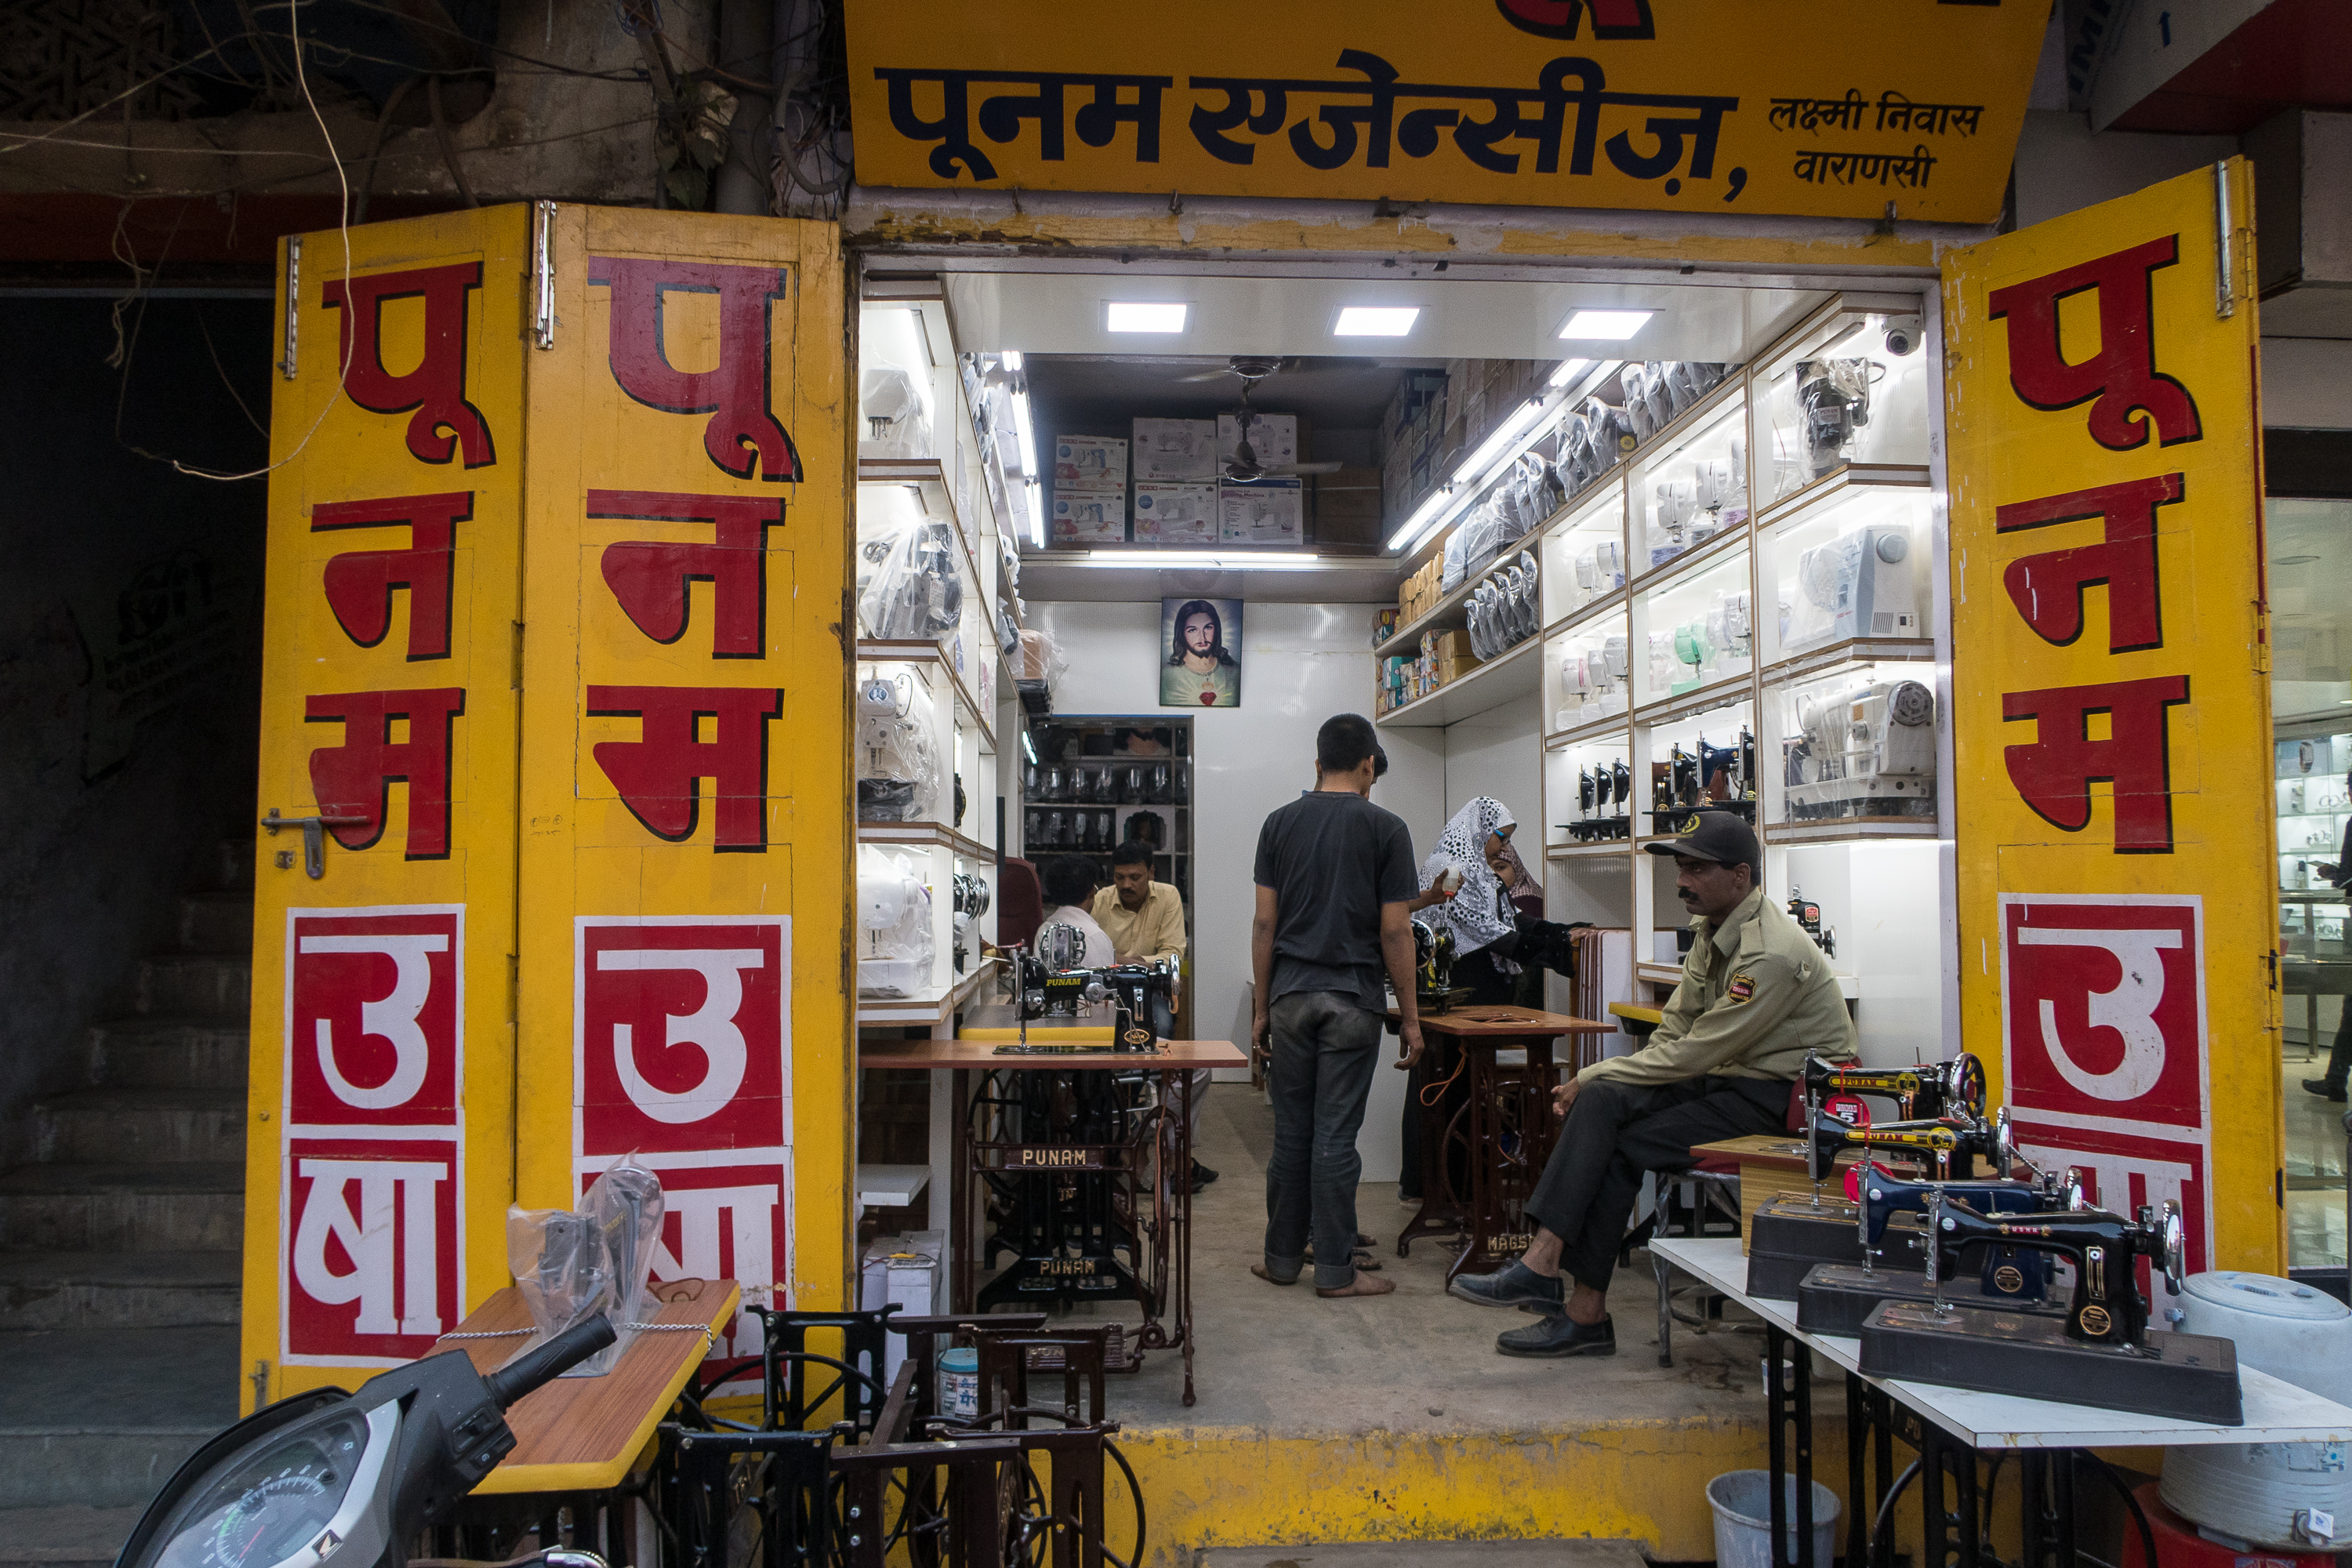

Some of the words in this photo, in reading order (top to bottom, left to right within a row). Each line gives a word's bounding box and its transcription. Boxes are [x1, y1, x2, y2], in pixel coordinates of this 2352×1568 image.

[874, 67, 1173, 182] पूनम
[1768, 89, 1867, 136] लक्ष्मी
[1876, 90, 1984, 137] निवास
[1794, 144, 1937, 190] वाराणसी
[305, 260, 496, 861] पूनम
[586, 256, 804, 853] पूनम
[1989, 233, 2203, 854] पूनम
[1046, 978, 1081, 986] PUNAM
[1840, 1112, 1855, 1123] 5
[1871, 1133, 1903, 1142] UNAM
[1022, 1149, 1086, 1165] PUNAM
[1040, 1260, 1095, 1275] PUNAM
